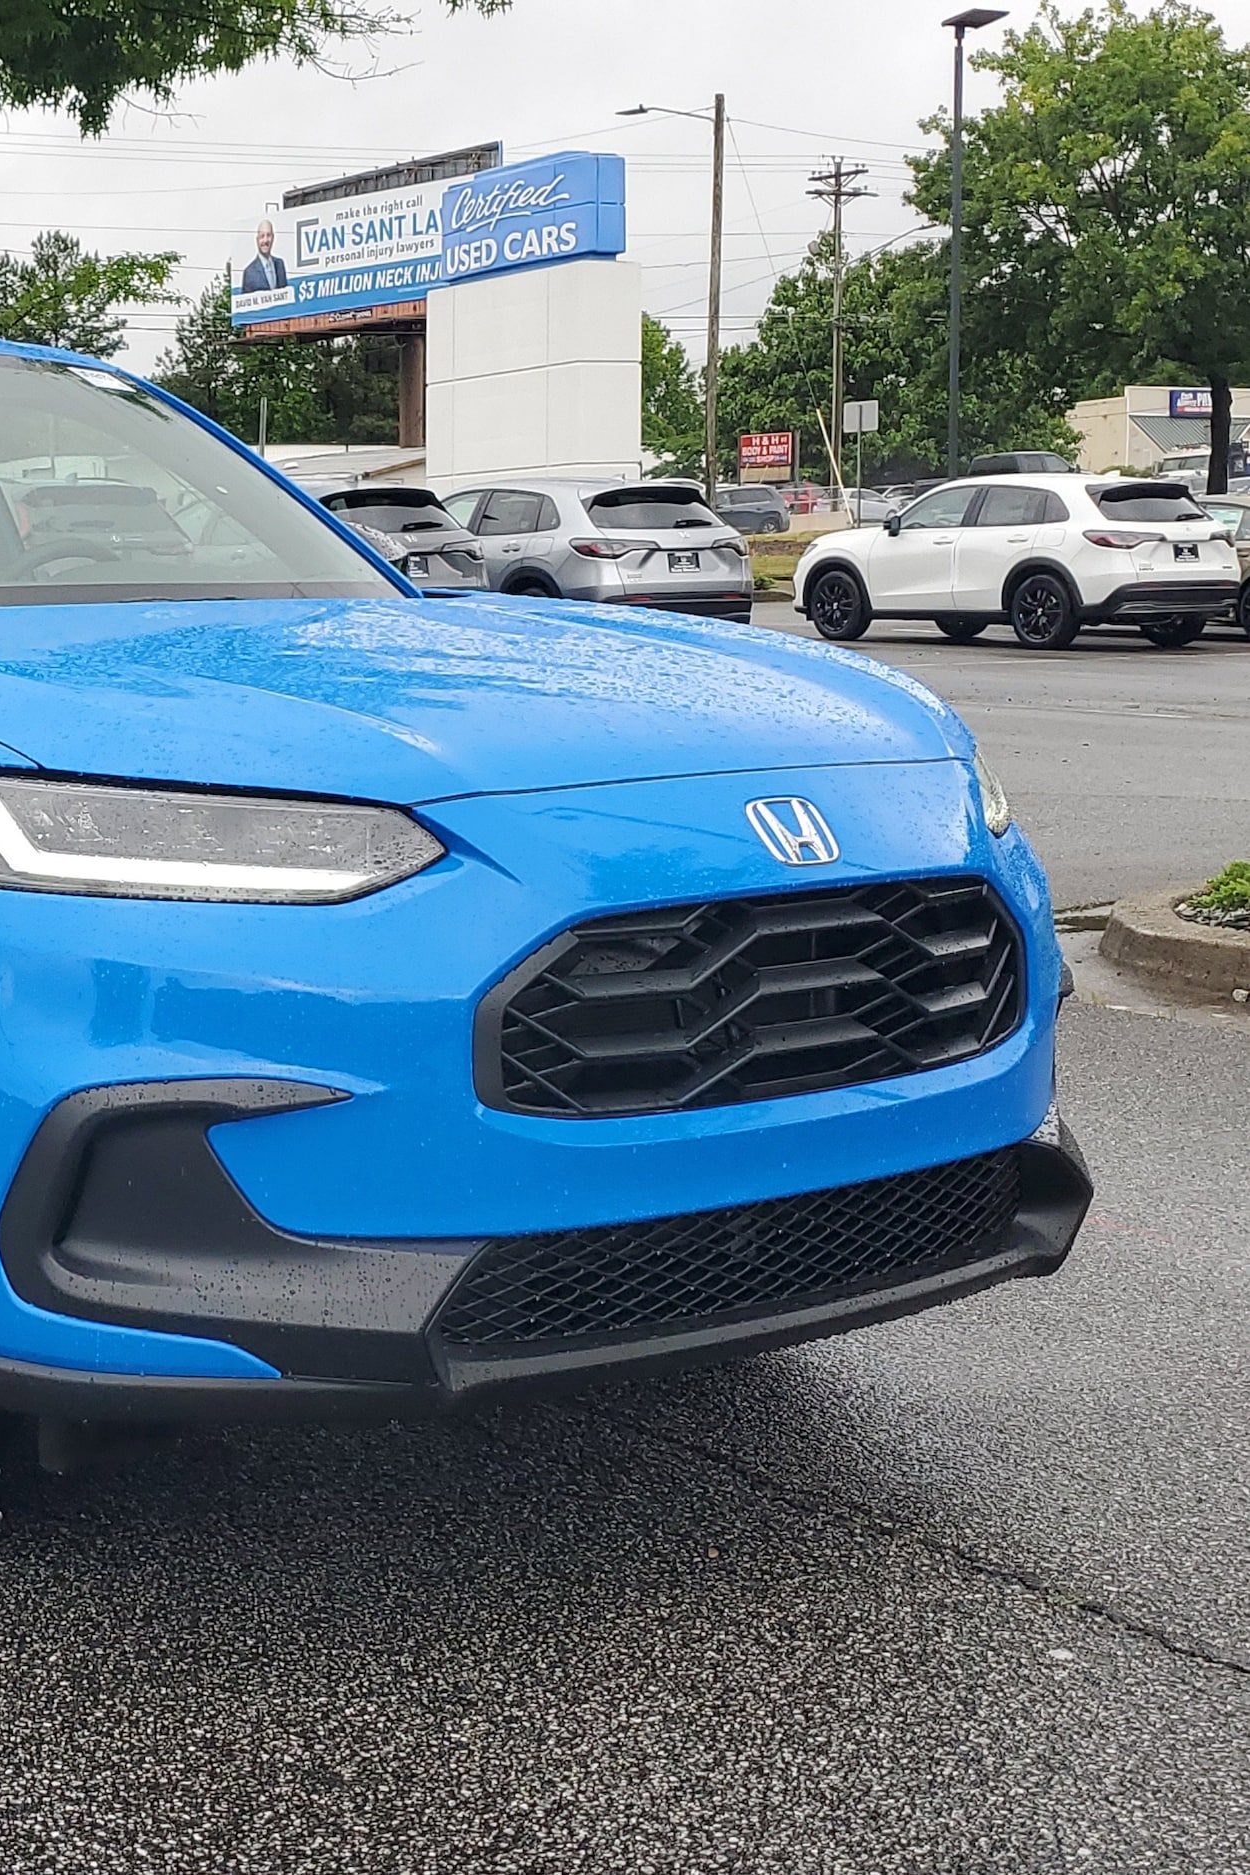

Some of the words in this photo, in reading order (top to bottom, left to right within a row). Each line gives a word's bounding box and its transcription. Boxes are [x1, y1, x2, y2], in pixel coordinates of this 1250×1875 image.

[336, 207, 361, 221] make
[363, 204, 378, 217] the
[380, 199, 404, 215] right
[406, 194, 423, 208] call
[451, 174, 570, 232] Certified
[304, 225, 346, 254] VAN
[351, 214, 407, 247] SANT
[412, 207, 444, 237] LA
[325, 248, 365, 268] personal
[367, 245, 394, 260] injury
[396, 238, 435, 254] lawyers
[446, 238, 498, 275] USED
[503, 222, 578, 262] CARS
[298, 280, 315, 302] $3
[317, 272, 372, 298] MILLION
[375, 266, 413, 289] NECK
[742, 446, 761, 456] BODY
[752, 437, 760, 446] H
[771, 435, 779, 445] H
